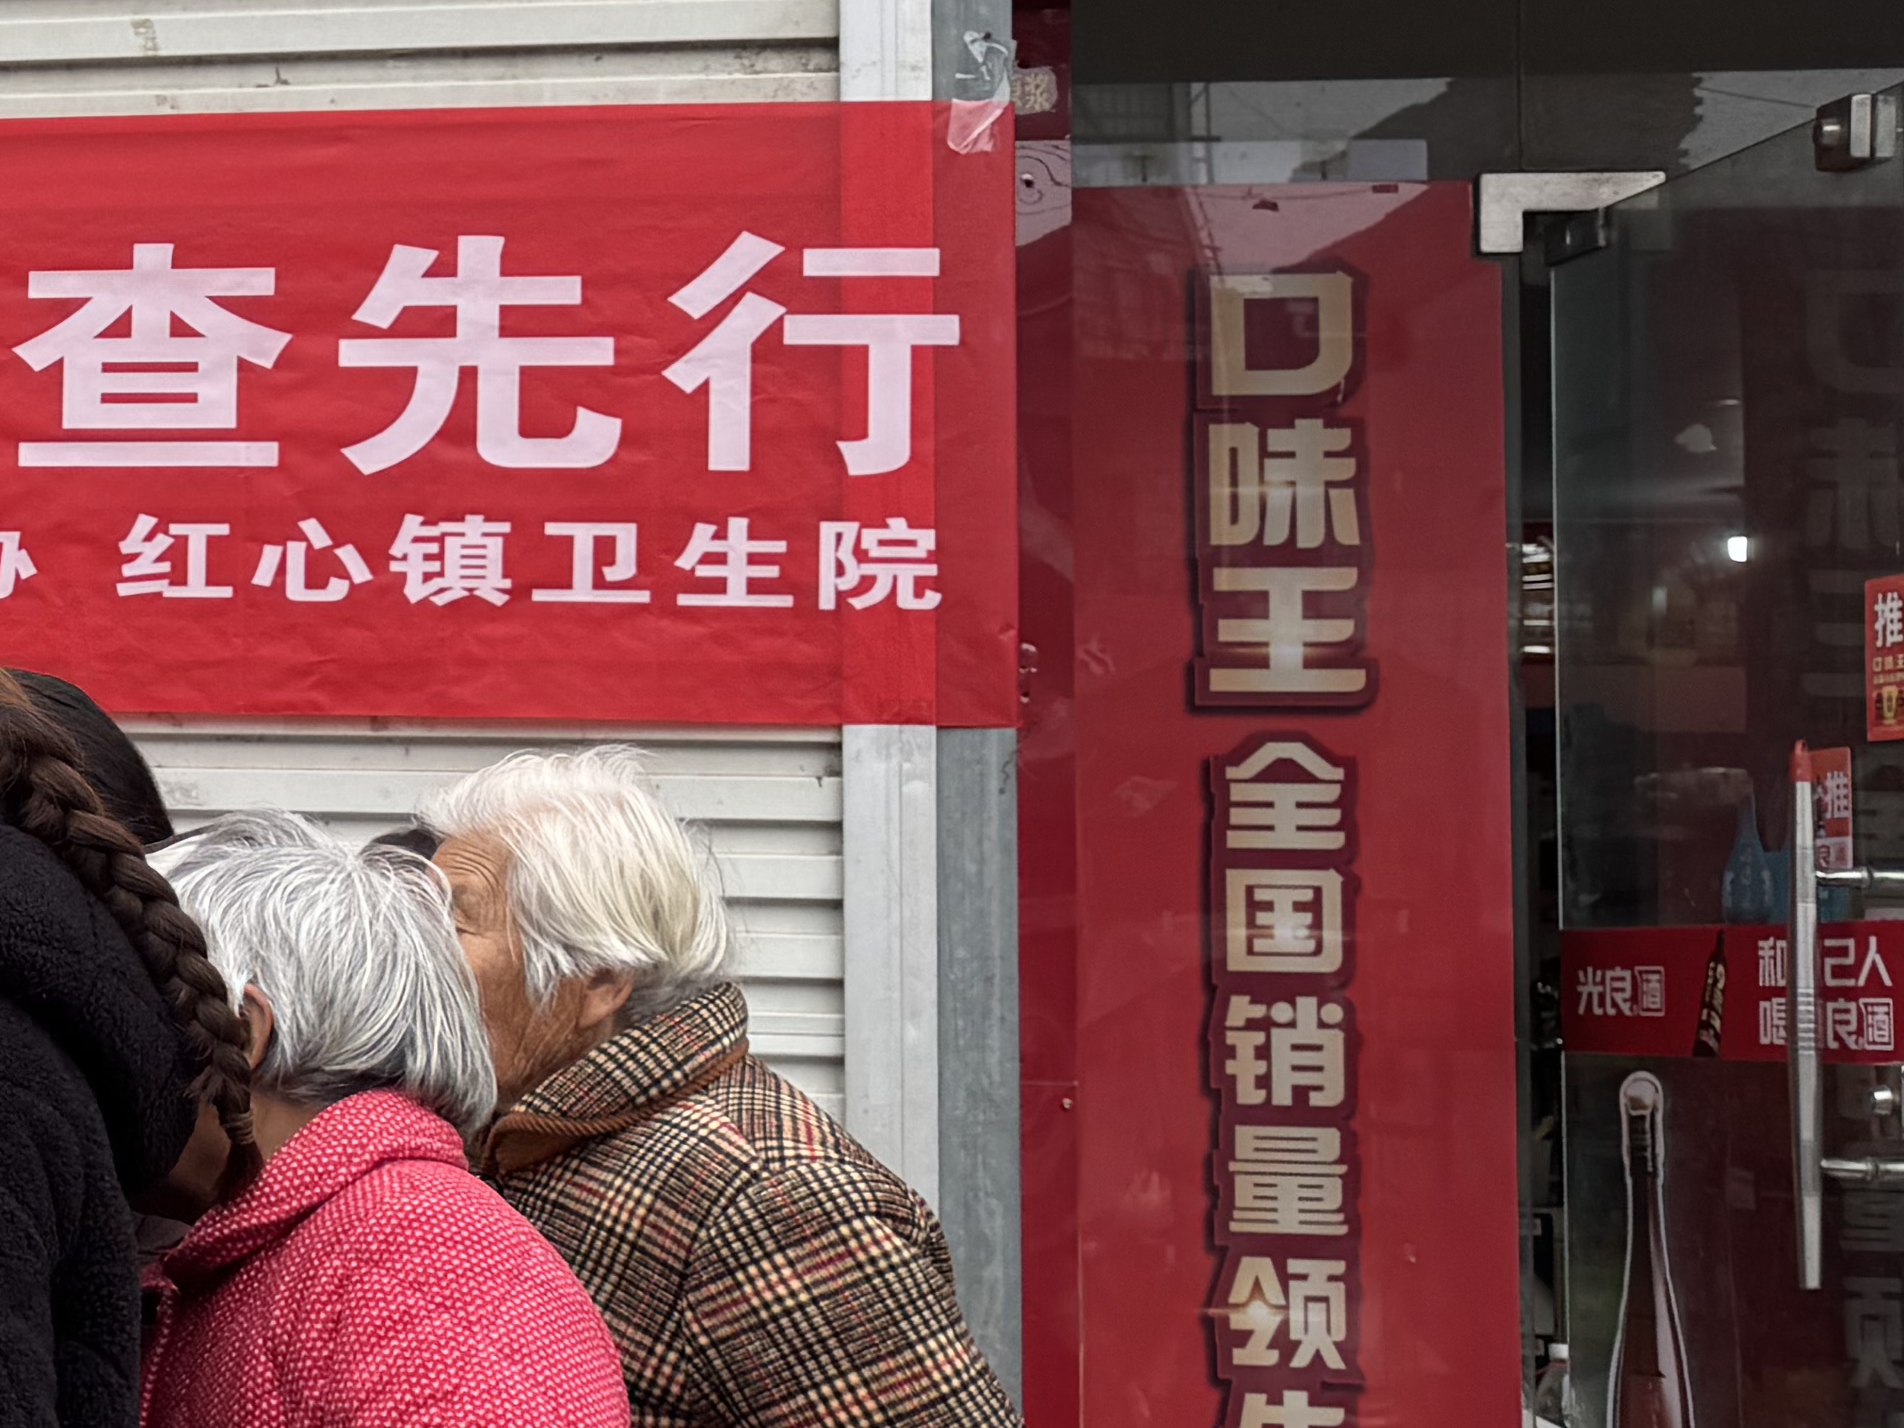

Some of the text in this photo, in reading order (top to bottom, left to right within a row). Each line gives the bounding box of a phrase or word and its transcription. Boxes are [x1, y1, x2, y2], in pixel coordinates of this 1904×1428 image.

[115, 512, 944, 613] 红心镇卫生院
[1758, 936, 1892, 988] 和己人
[1758, 997, 1895, 1051] 喝良酒
